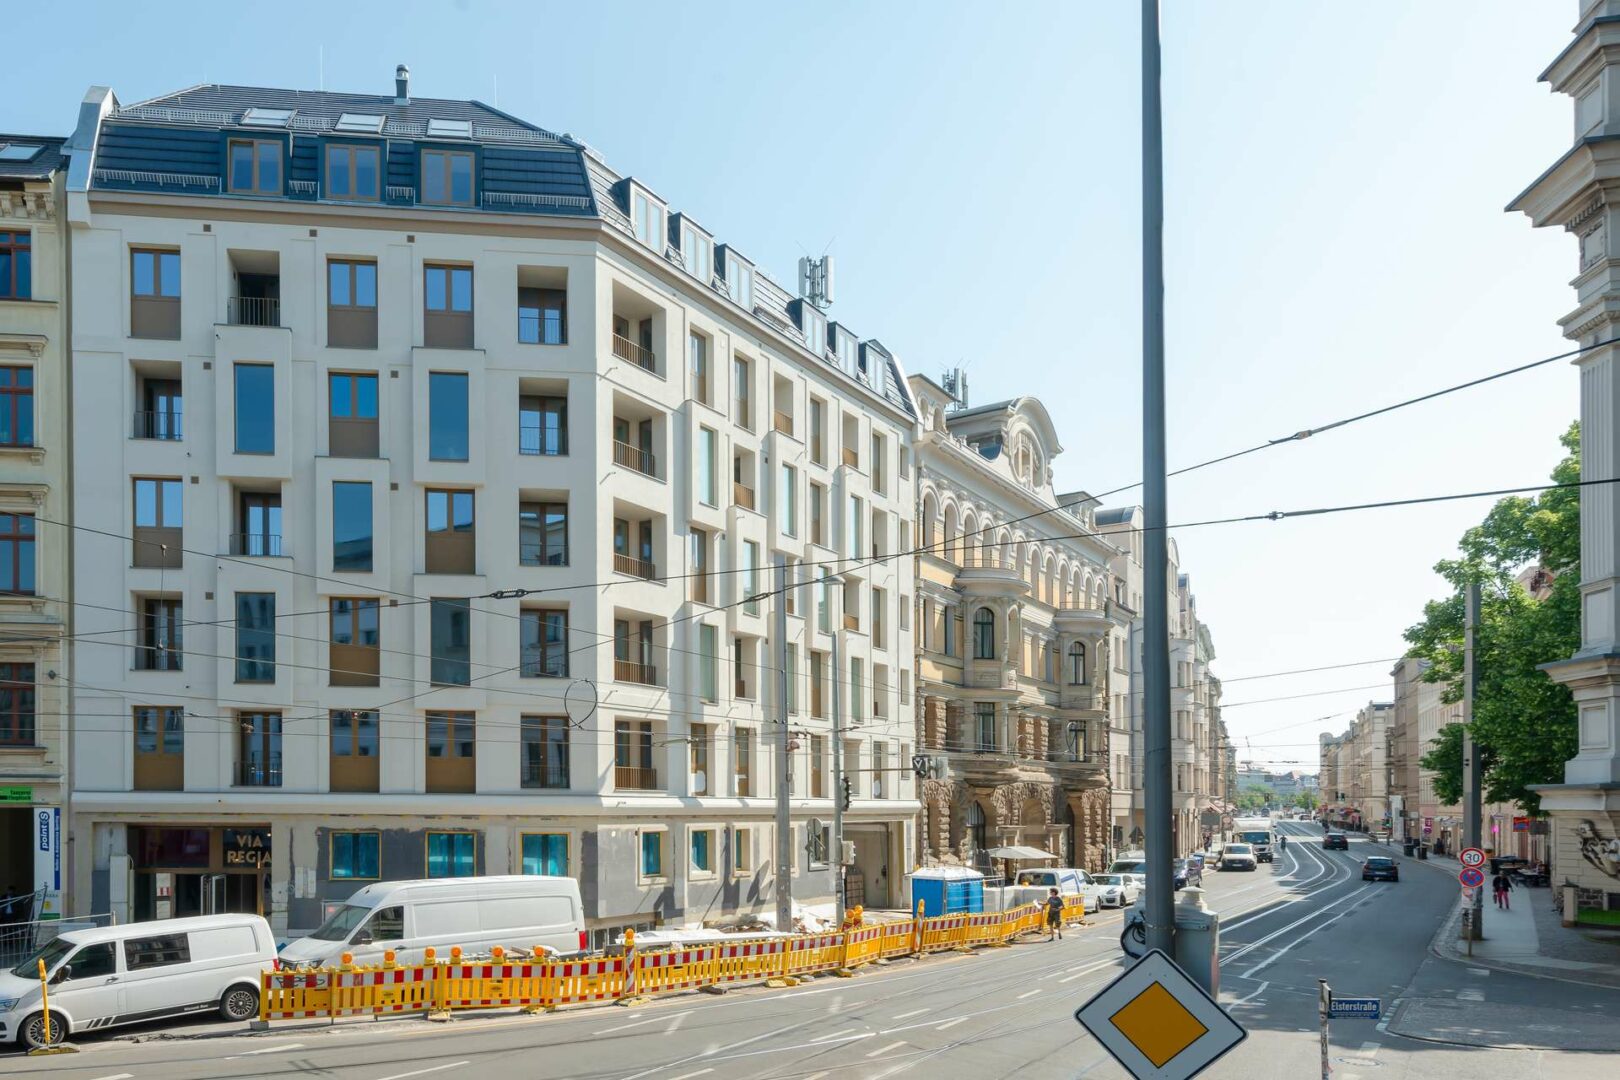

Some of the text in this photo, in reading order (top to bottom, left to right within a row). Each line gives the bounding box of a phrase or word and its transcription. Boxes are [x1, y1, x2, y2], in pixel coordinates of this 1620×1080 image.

[41, 825, 49, 849] point
[236, 835, 263, 848] VIA
[227, 850, 273, 864] REGIA
[1465, 853, 1480, 863] 30
[1331, 1001, 1377, 1011] Elsterstraße
